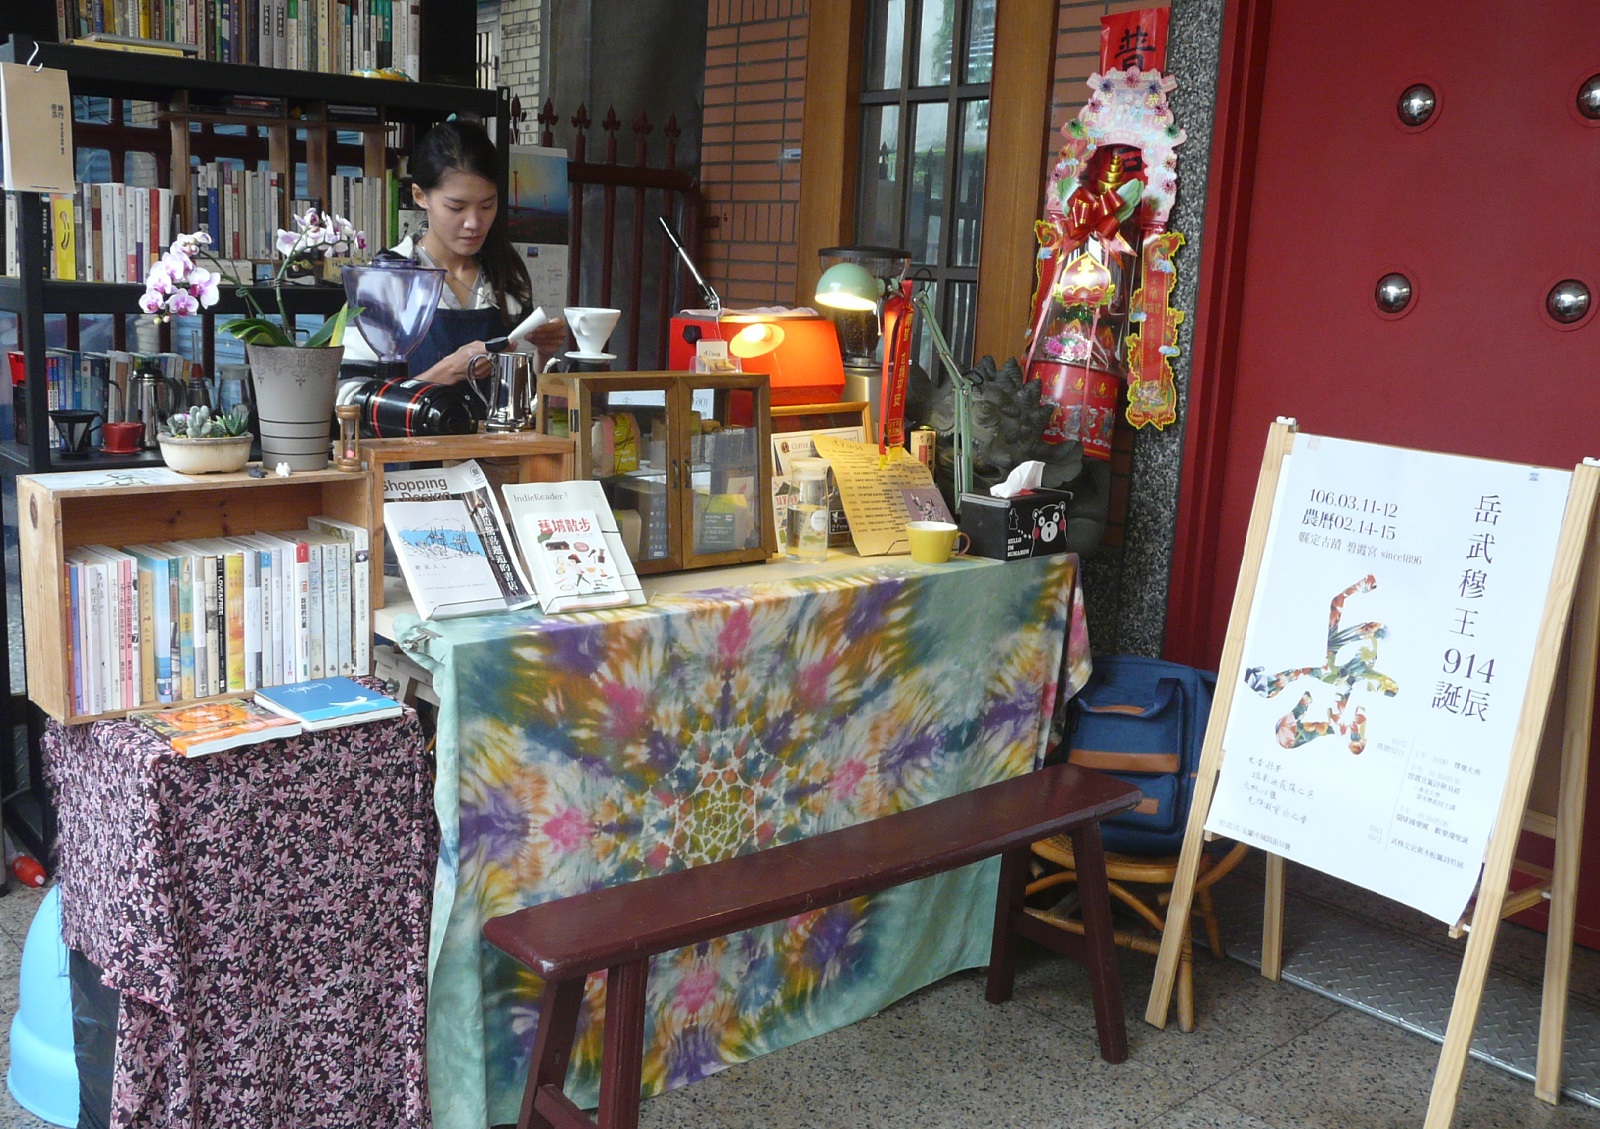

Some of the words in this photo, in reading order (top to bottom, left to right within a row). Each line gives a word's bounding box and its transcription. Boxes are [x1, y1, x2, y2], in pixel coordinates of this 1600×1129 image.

[383, 478, 448, 492] Shopping
[513, 492, 563, 502] IndieReader
[1310, 489, 1398, 518] 106.03.11-12
[1449, 494, 1502, 638] 岳武穆王
[1442, 648, 1496, 684] 914
[1431, 680, 1491, 722] 誕辰
